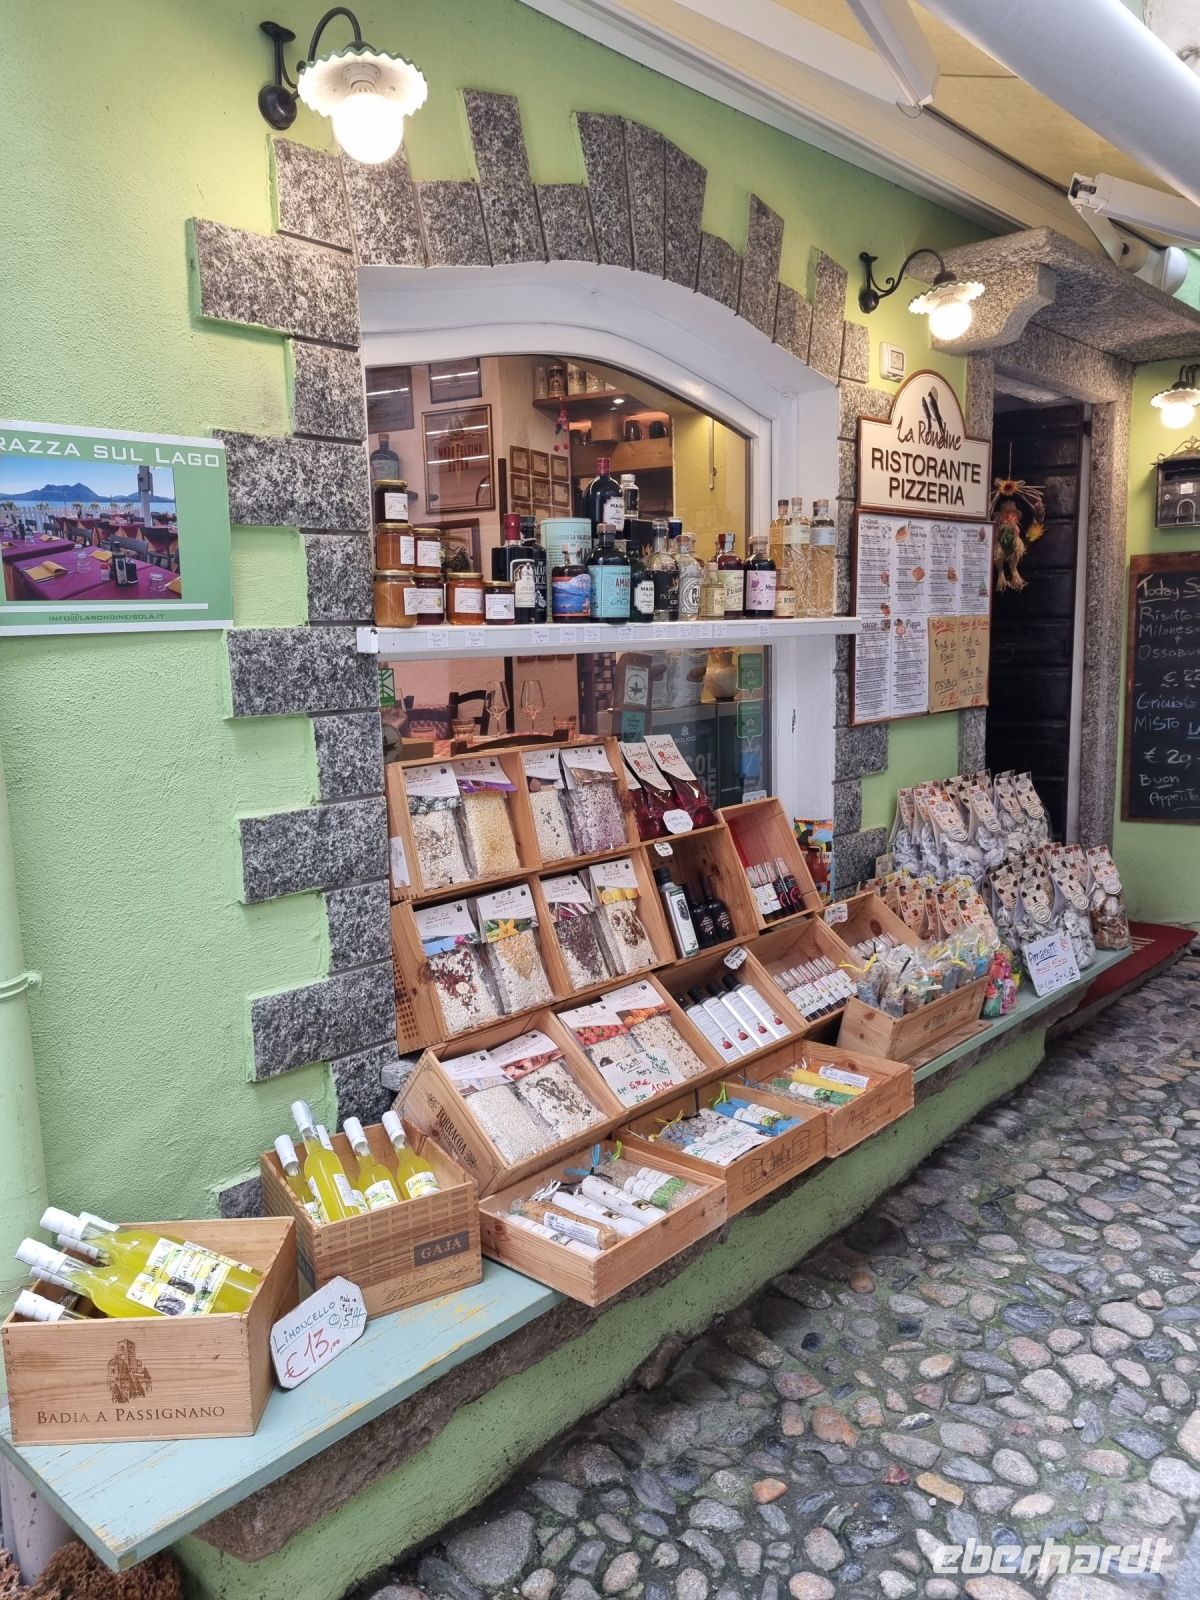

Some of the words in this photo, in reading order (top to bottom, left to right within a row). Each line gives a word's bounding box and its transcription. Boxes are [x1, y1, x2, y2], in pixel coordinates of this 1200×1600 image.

[896, 416, 914, 443] La
[94, 445, 143, 462] SUL
[871, 448, 982, 484] RISTORANTE
[889, 477, 965, 506] PIZZERIA
[1136, 574, 1179, 602] Today
[1140, 606, 1194, 622] Risotto
[1139, 774, 1180, 787] Buon
[421, 1238, 462, 1258] GAJA
[37, 1411, 89, 1424] BADIA
[97, 1412, 107, 1421] A
[116, 1406, 225, 1421] PASSIGNANO
